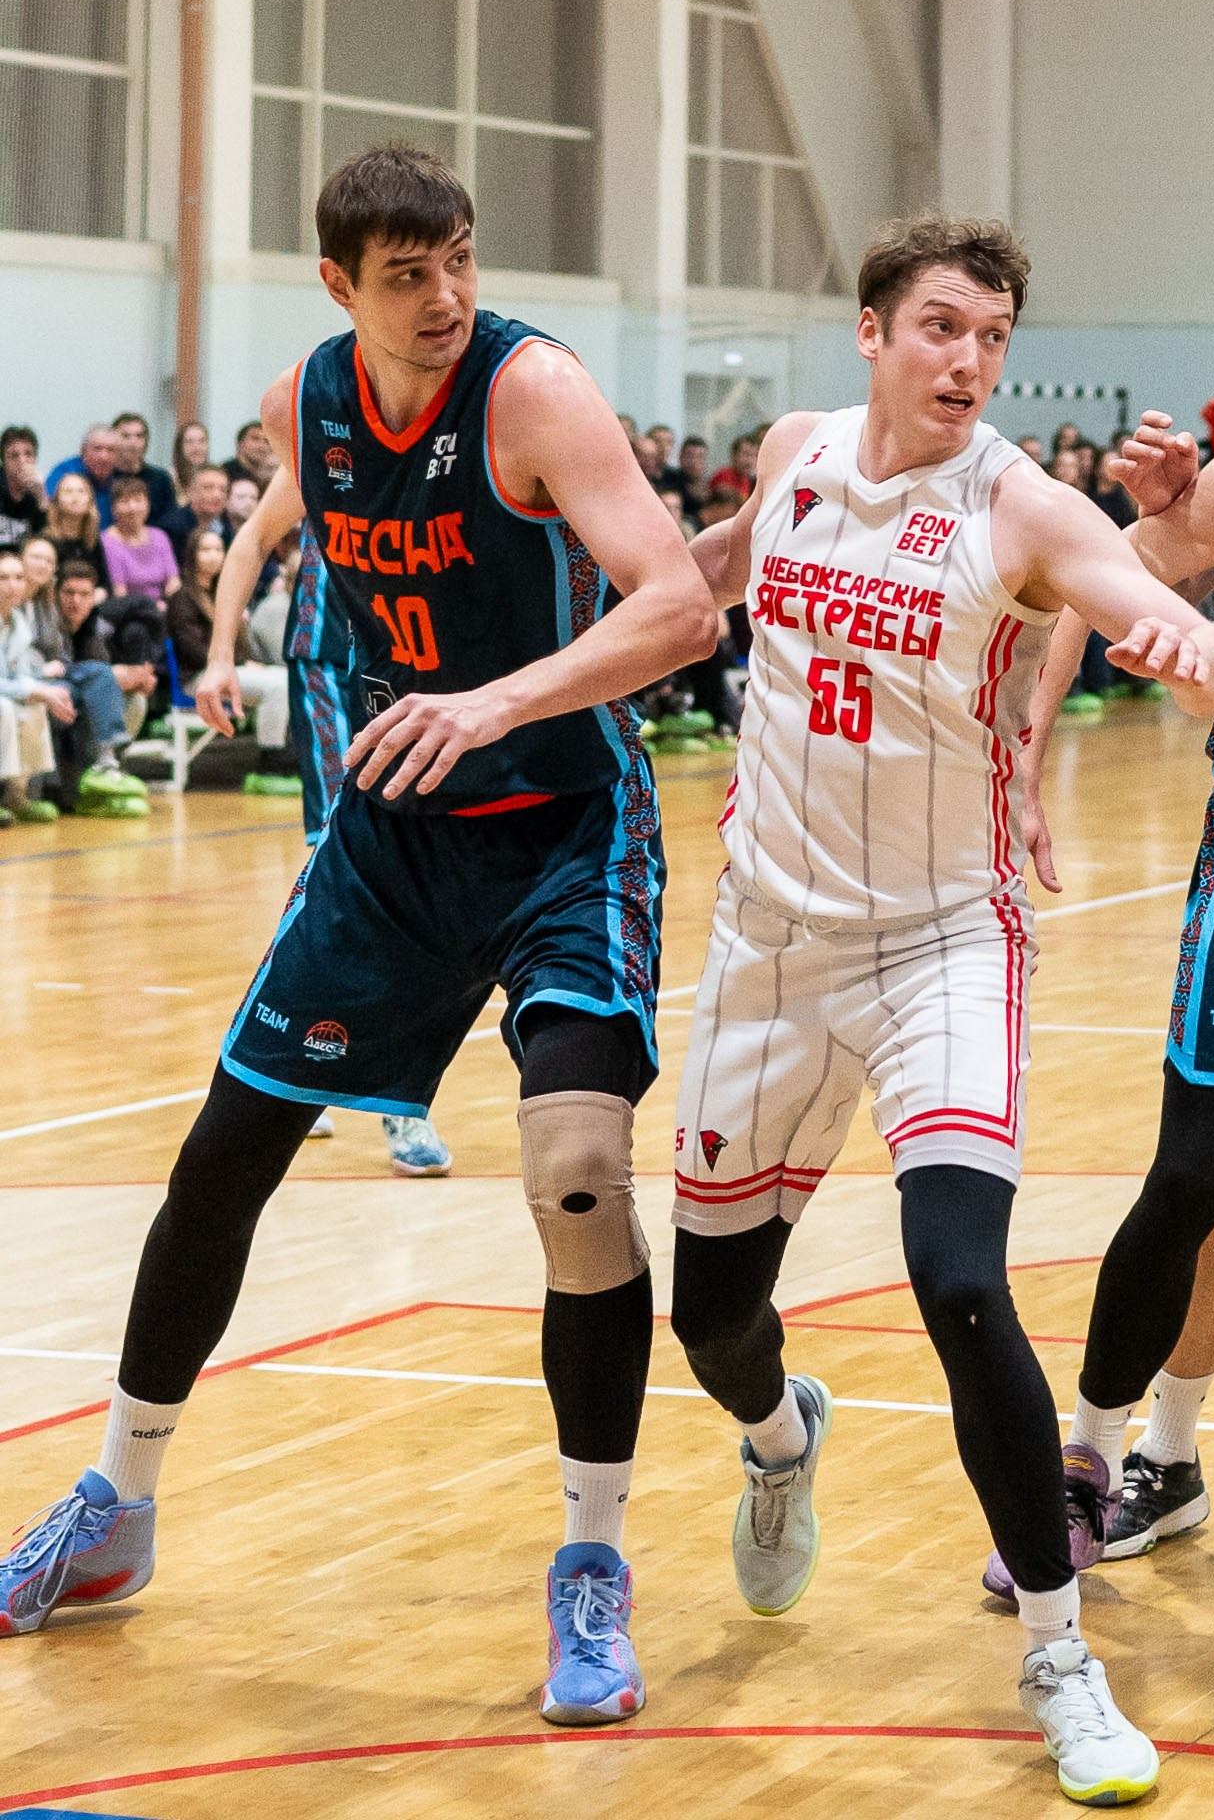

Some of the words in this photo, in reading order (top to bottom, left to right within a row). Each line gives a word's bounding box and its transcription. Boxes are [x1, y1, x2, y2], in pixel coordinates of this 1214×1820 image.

[321, 419, 351, 440] TEAM
[426, 454, 458, 480] BT
[907, 512, 956, 538] FON
[897, 532, 945, 557] BET
[762, 555, 946, 618] ЧЕБОКСАРСКИЕ
[370, 594, 440, 671] 10
[752, 582, 943, 661] ЯСТРЕБЫ
[806, 657, 873, 744] 55
[255, 1002, 290, 1034] TEAM
[131, 1426, 176, 1439] adida
